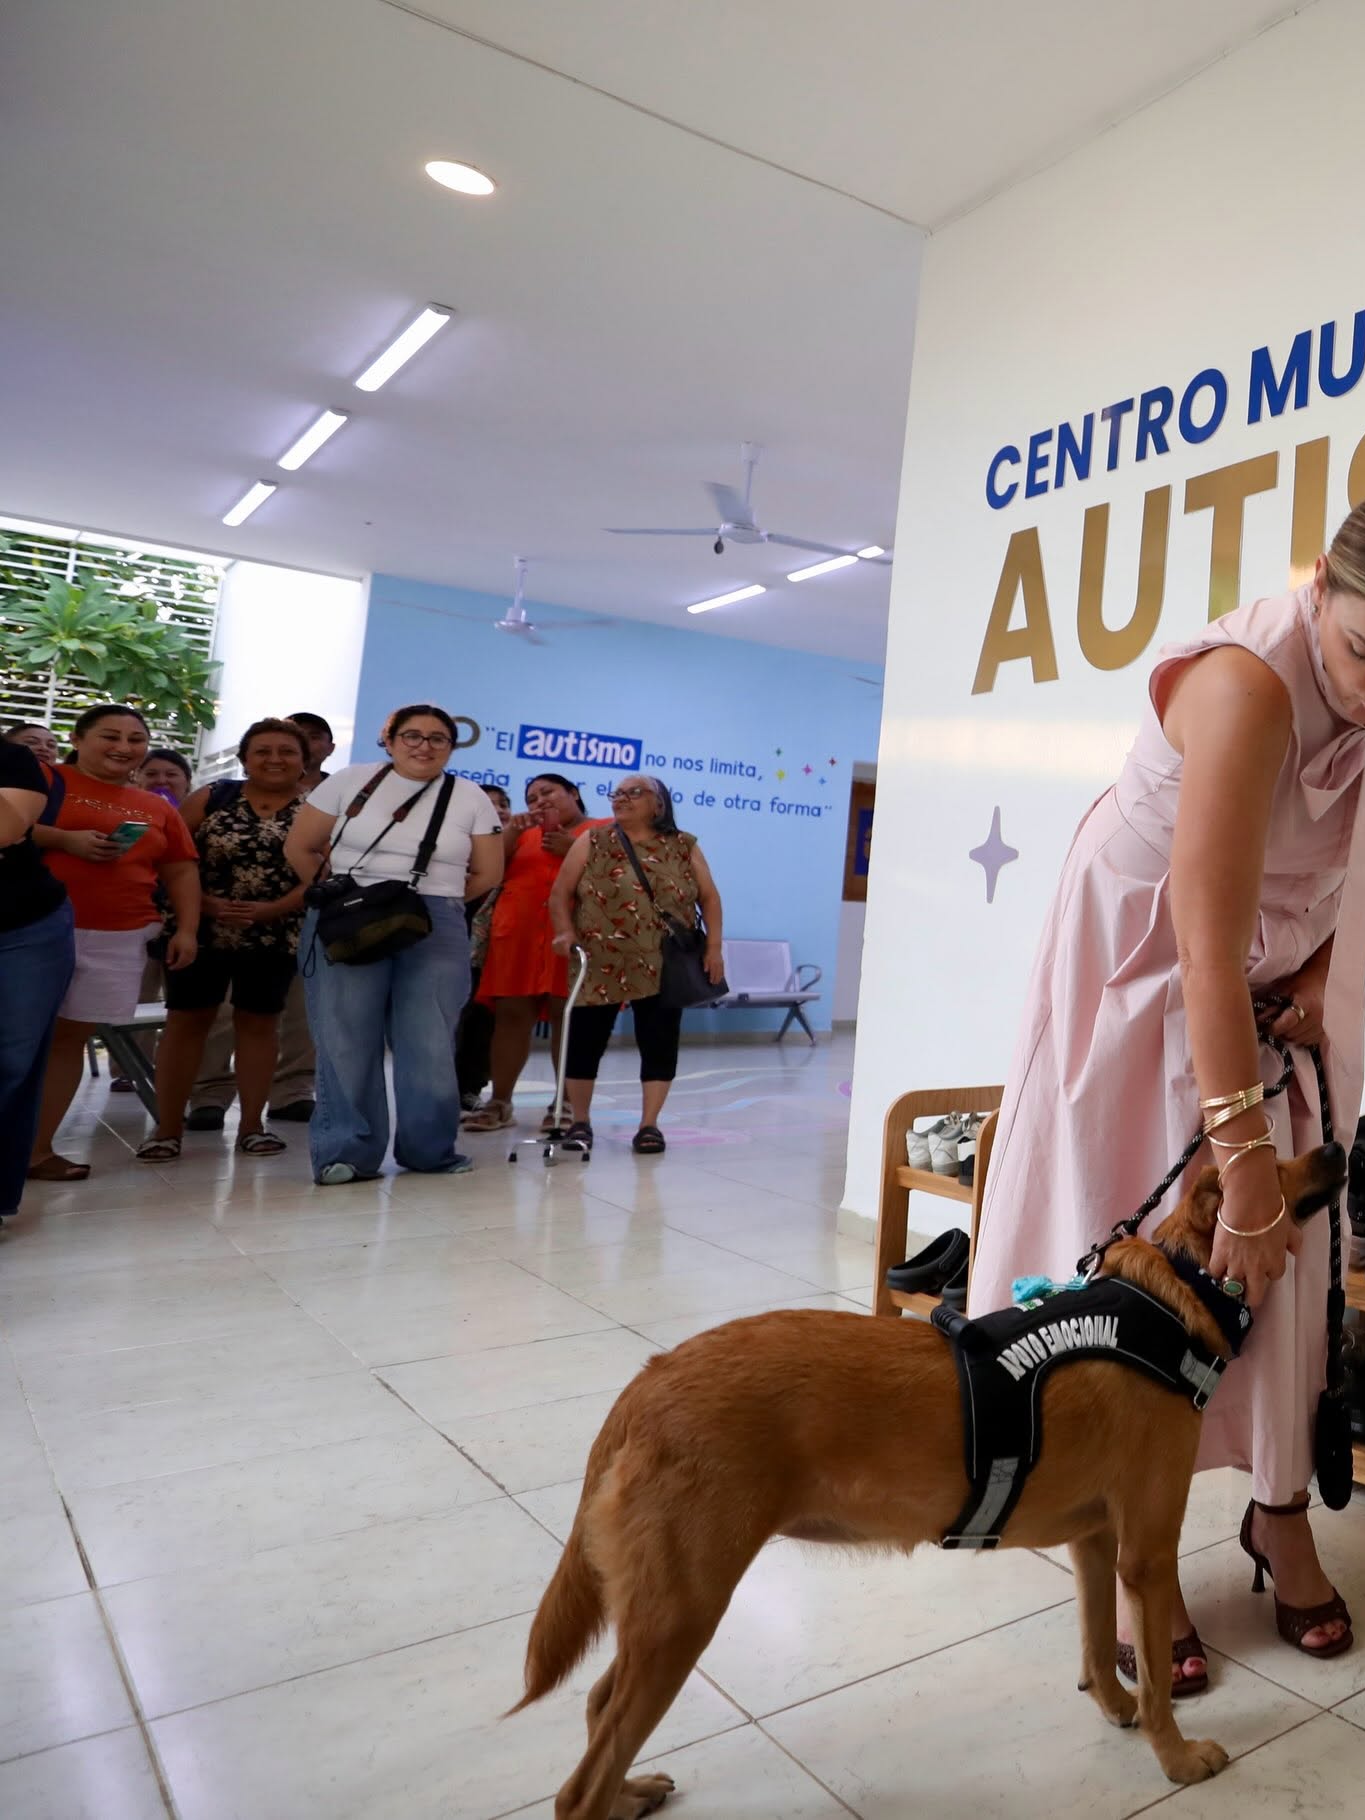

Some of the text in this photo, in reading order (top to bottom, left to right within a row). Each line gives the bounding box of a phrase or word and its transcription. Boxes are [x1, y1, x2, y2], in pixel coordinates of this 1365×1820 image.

[985, 368, 1228, 511] CENTRO
[522, 728, 637, 767] autismo
[645, 753, 667, 768] no
[672, 756, 703, 772] nos
[709, 757, 763, 781] limita,
[693, 790, 716, 807] de
[723, 796, 761, 812] otra
[996, 1315, 1119, 1381] APOYO EMOCIONAL
